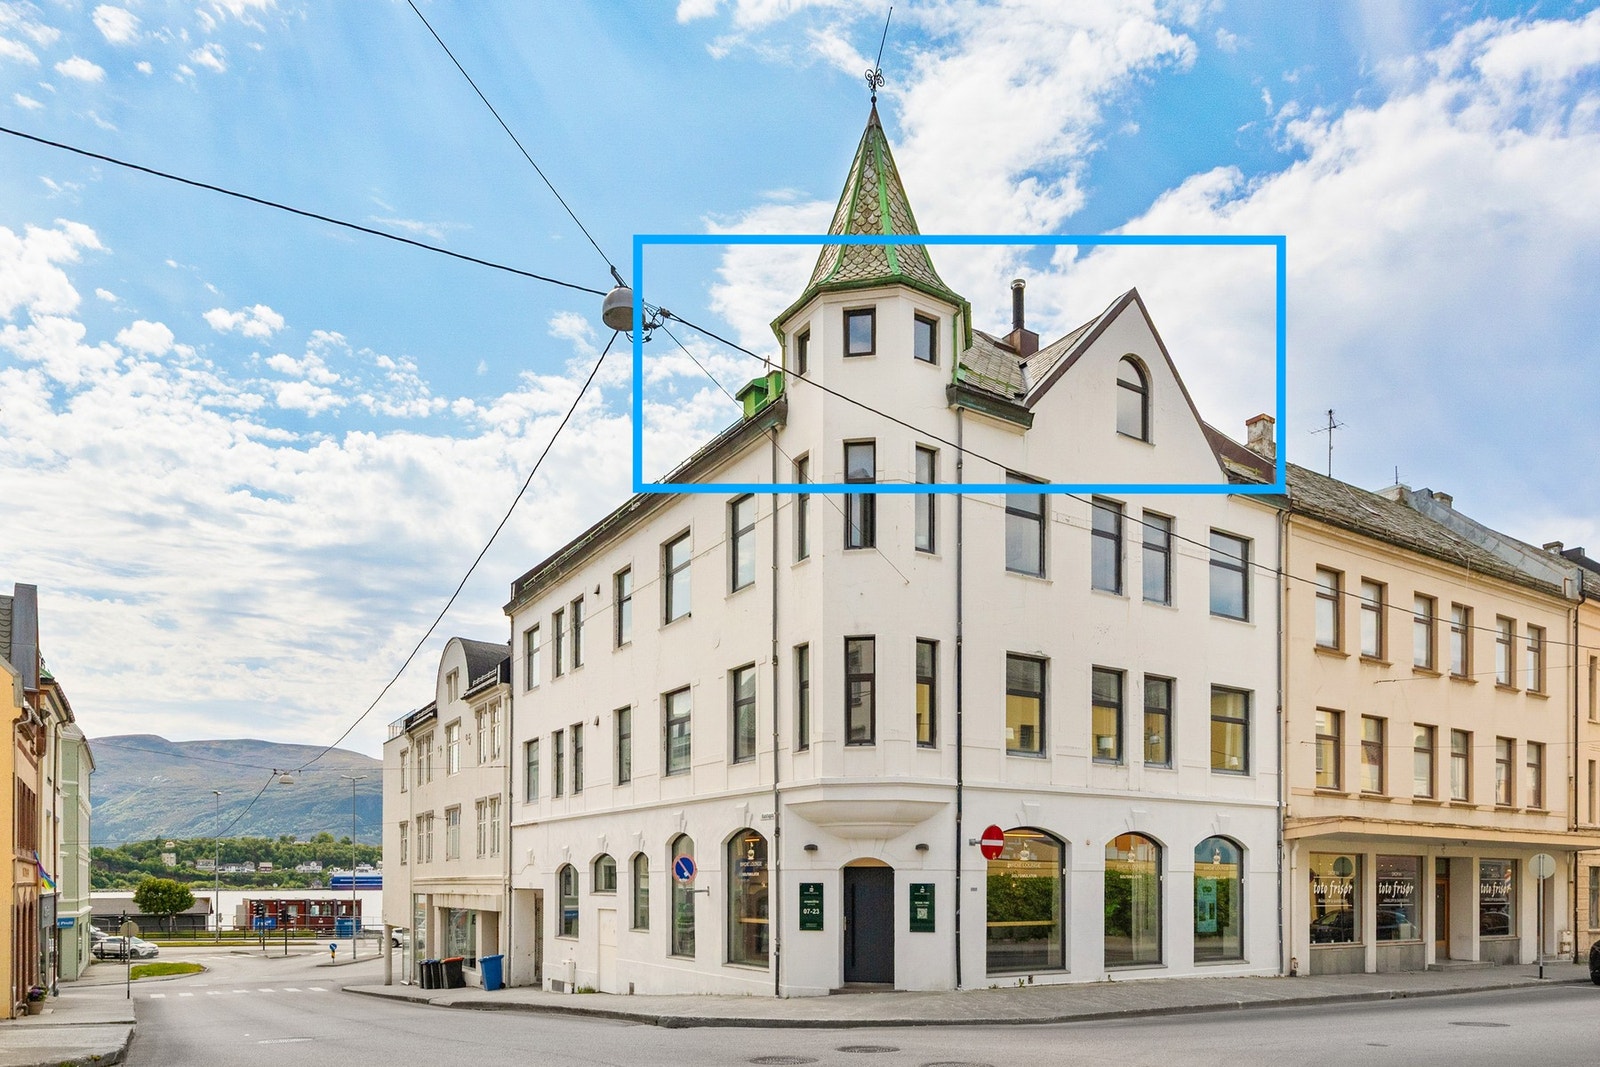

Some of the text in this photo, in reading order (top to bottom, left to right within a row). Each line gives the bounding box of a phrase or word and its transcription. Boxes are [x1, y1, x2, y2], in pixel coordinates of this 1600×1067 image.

[1313, 880, 1352, 898] toto frisør
[1378, 880, 1414, 898] toto frisør
[1480, 883, 1491, 894] toto
